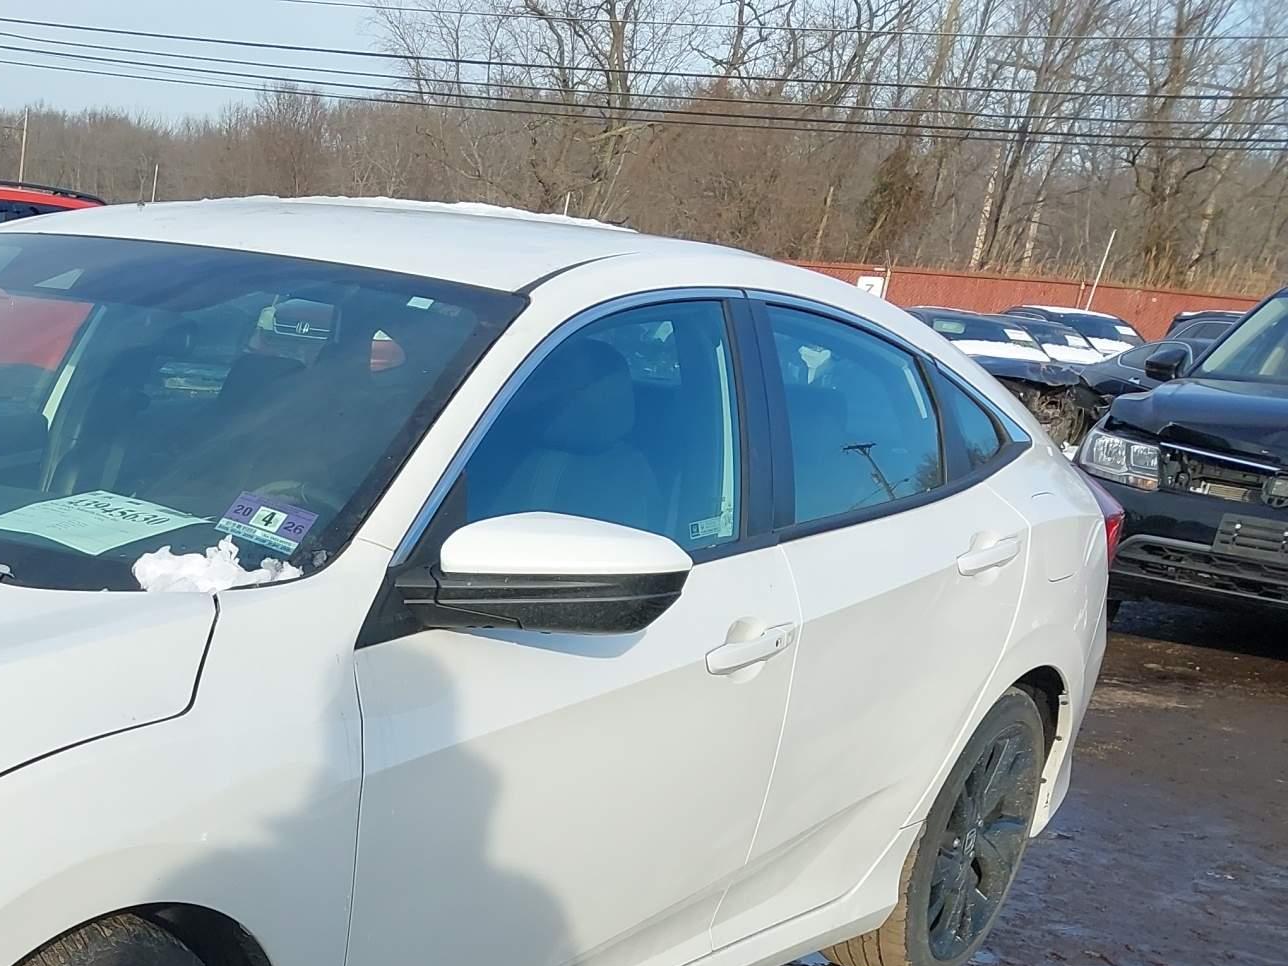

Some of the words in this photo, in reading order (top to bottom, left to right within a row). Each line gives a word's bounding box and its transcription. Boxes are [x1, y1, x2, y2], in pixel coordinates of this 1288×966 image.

[233, 504, 253, 517] 20
[261, 511, 277, 527] 4
[283, 521, 305, 535] 26
